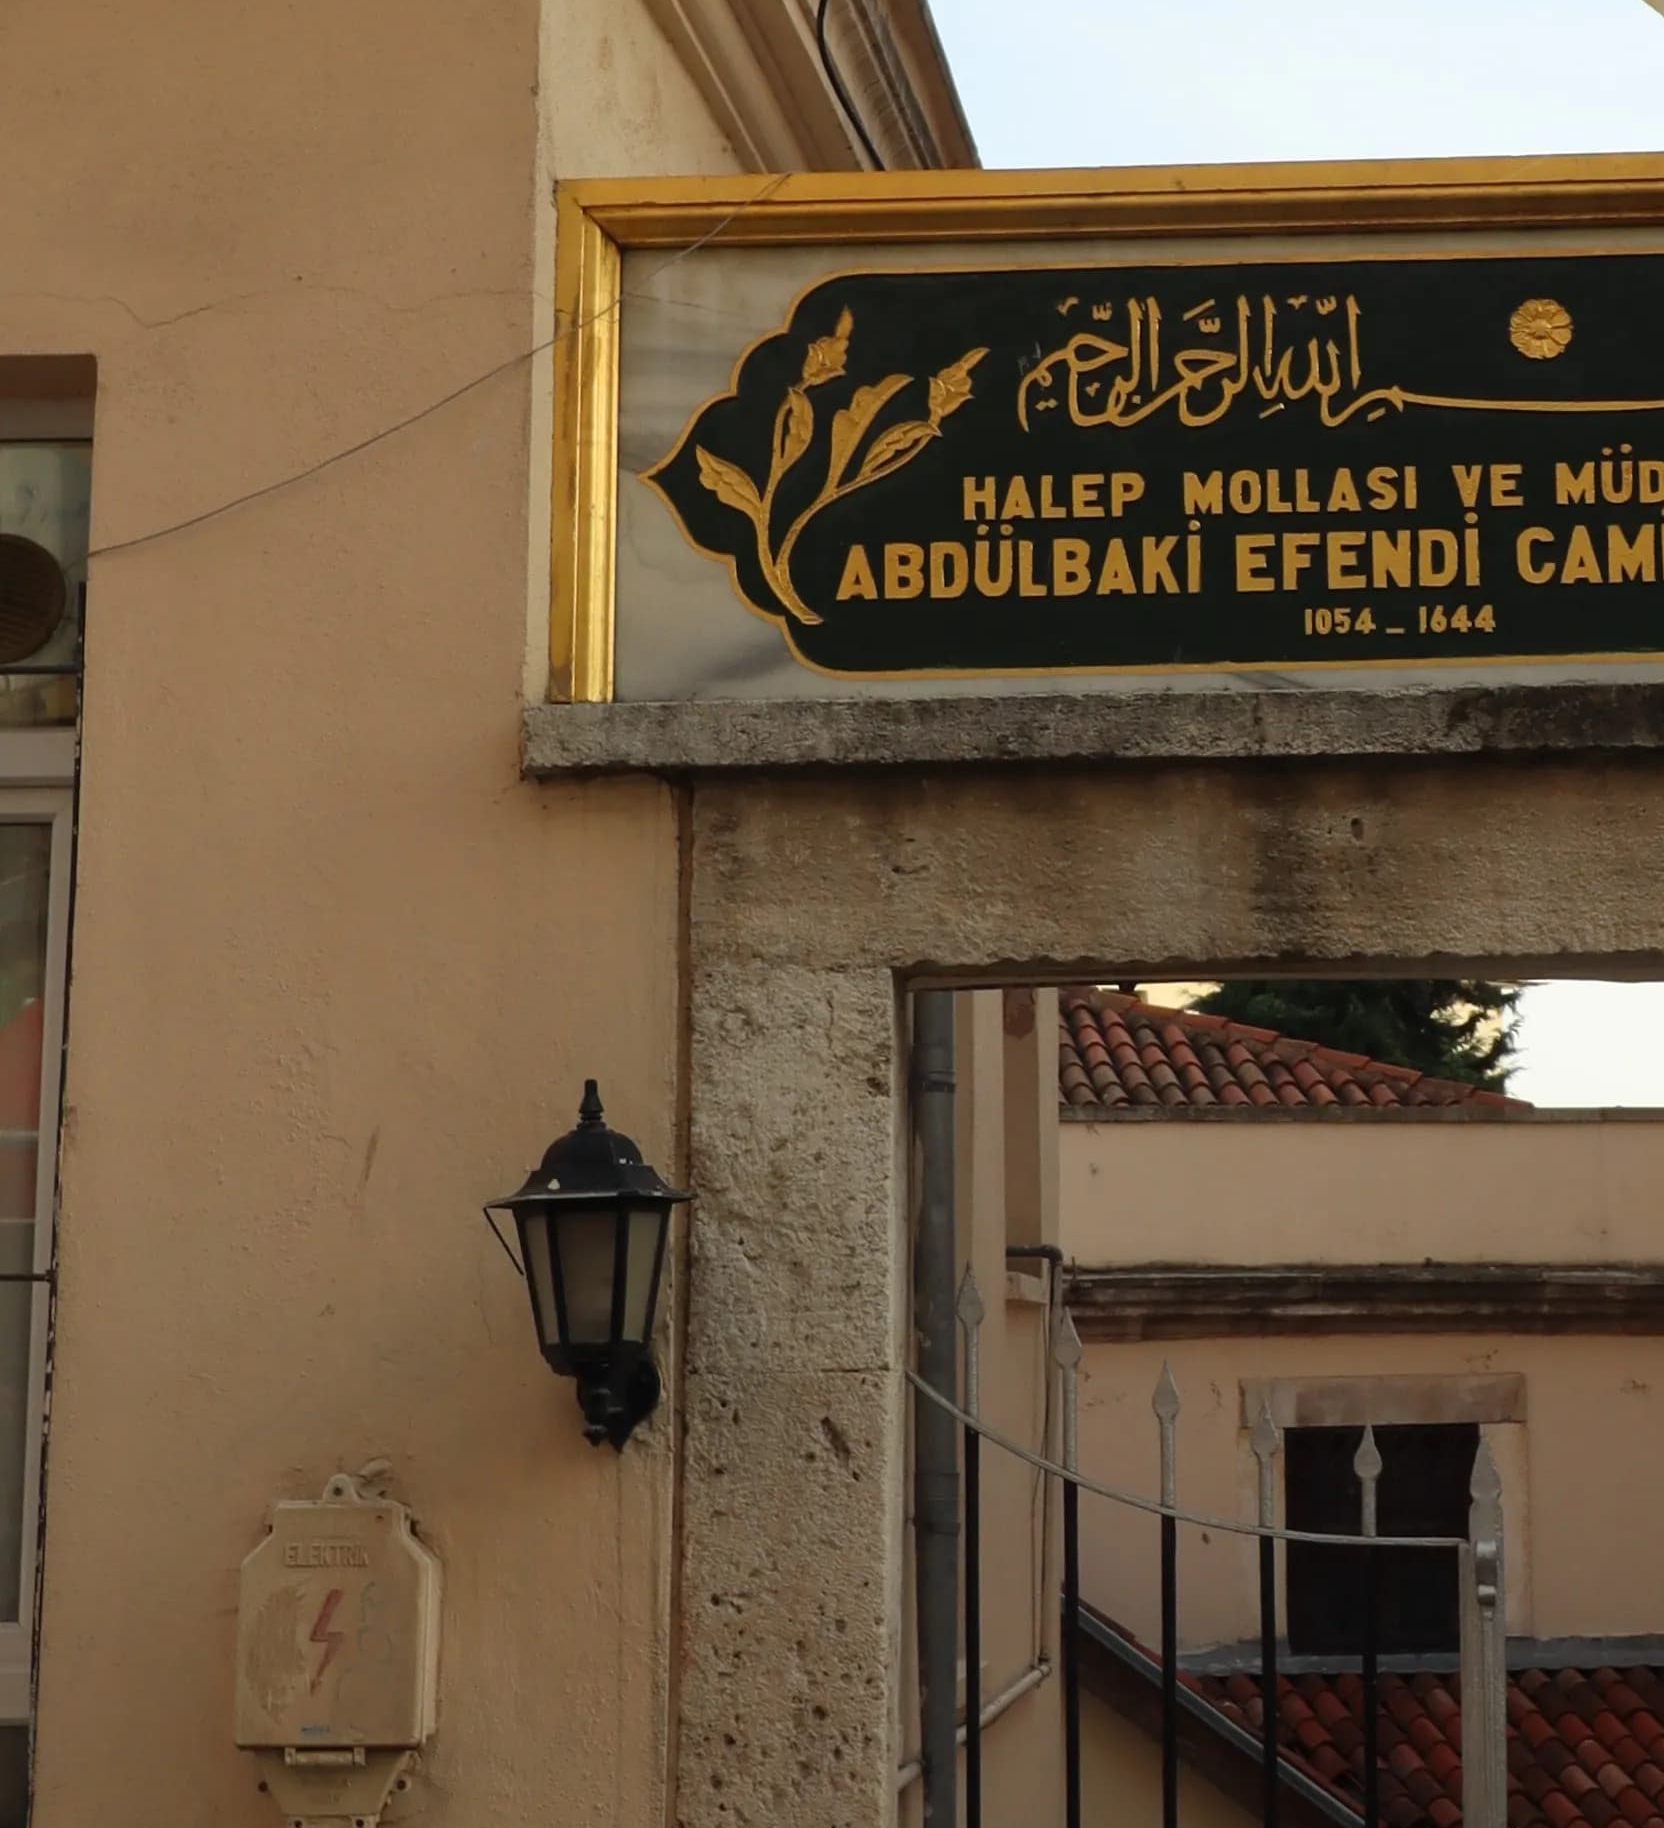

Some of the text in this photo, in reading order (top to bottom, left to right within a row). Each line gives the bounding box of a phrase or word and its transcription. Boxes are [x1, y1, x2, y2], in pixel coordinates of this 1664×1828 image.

[962, 470, 1147, 522] HALEP
[1182, 464, 1419, 517] MOLLASI
[1452, 461, 1524, 509] VE
[834, 518, 1203, 603] ABDÜLBAKİ
[1234, 510, 1480, 594] EFENDİ
[1303, 605, 1377, 636] 1054
[1417, 603, 1496, 634] 1644
